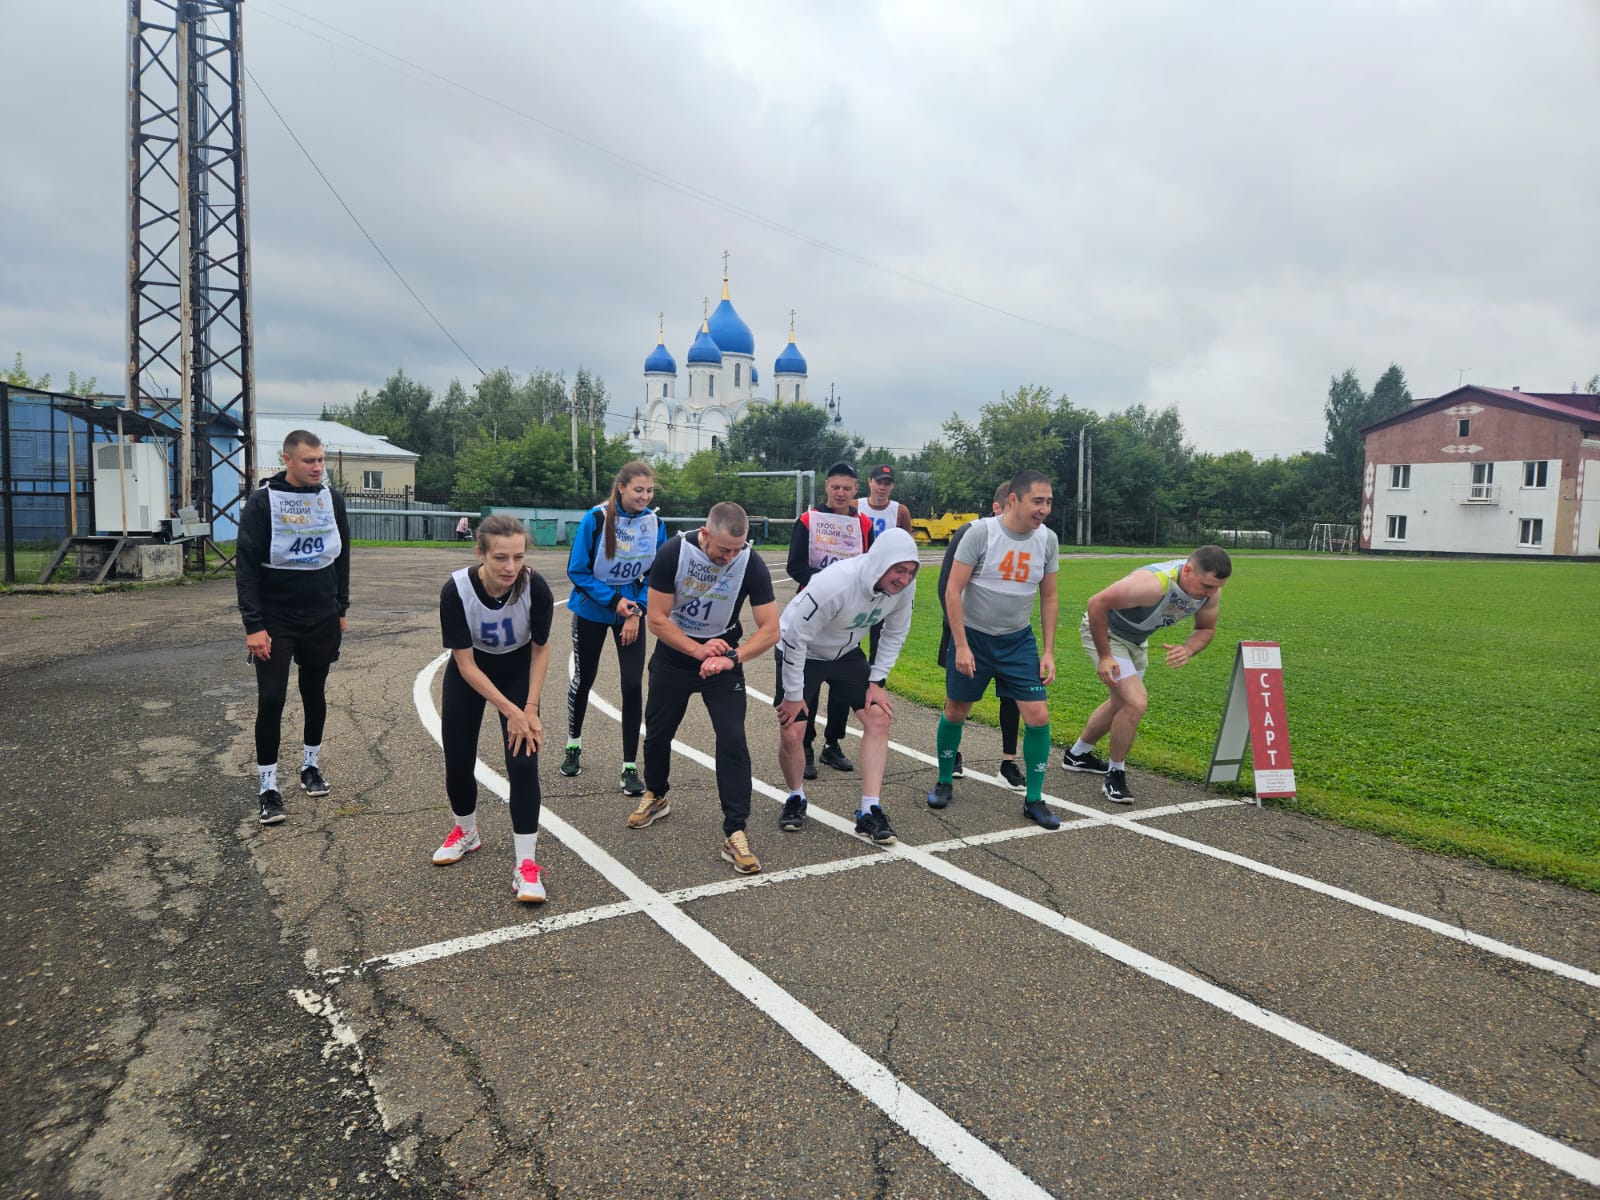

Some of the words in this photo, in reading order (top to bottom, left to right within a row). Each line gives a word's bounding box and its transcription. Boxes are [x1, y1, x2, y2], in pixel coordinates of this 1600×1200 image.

[280, 500, 304, 508] КРОСС
[280, 507, 312, 515] НАЦИИ
[815, 528, 841, 537] НАЦИИ
[816, 522, 836, 530] КРОСС
[289, 536, 325, 556] 469
[609, 561, 642, 578] 480
[998, 550, 1032, 583] 45
[687, 568, 718, 583] НАЦИИ
[481, 617, 517, 648] 51
[1259, 672, 1277, 766] СТАРТ
